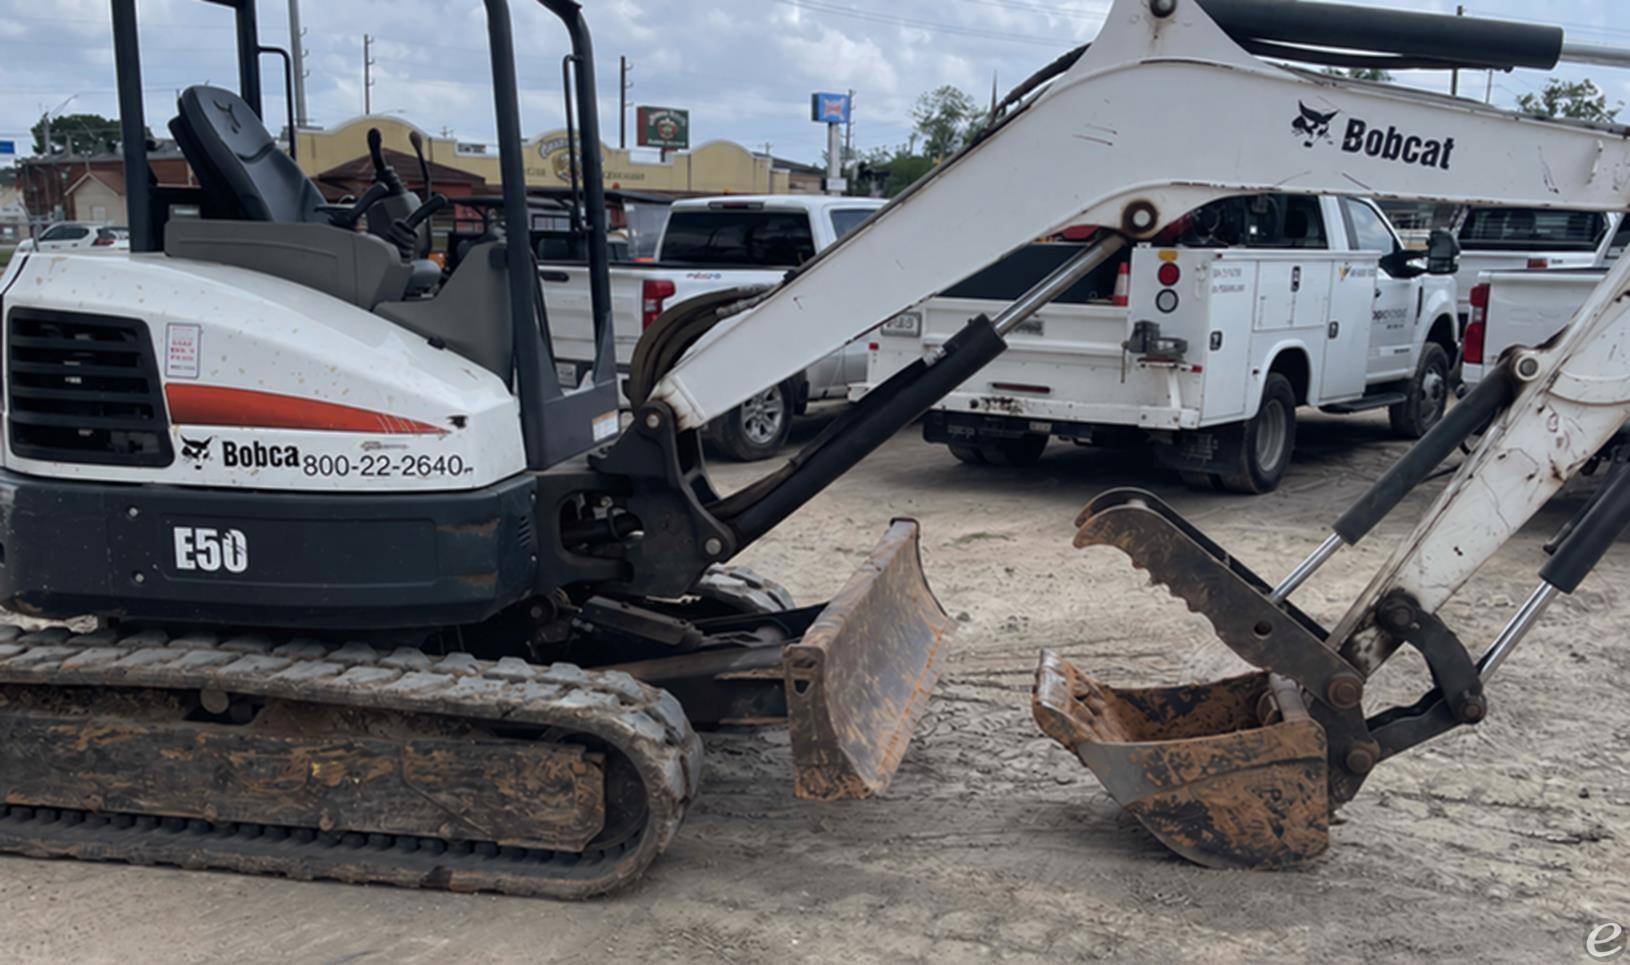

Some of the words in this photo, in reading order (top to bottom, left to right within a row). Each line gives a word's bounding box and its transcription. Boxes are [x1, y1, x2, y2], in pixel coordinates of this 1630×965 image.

[1341, 118, 1455, 170] Bobcat
[222, 441, 300, 468] Bobca
[303, 454, 463, 477] 800-22-2640
[173, 526, 248, 573] E50
